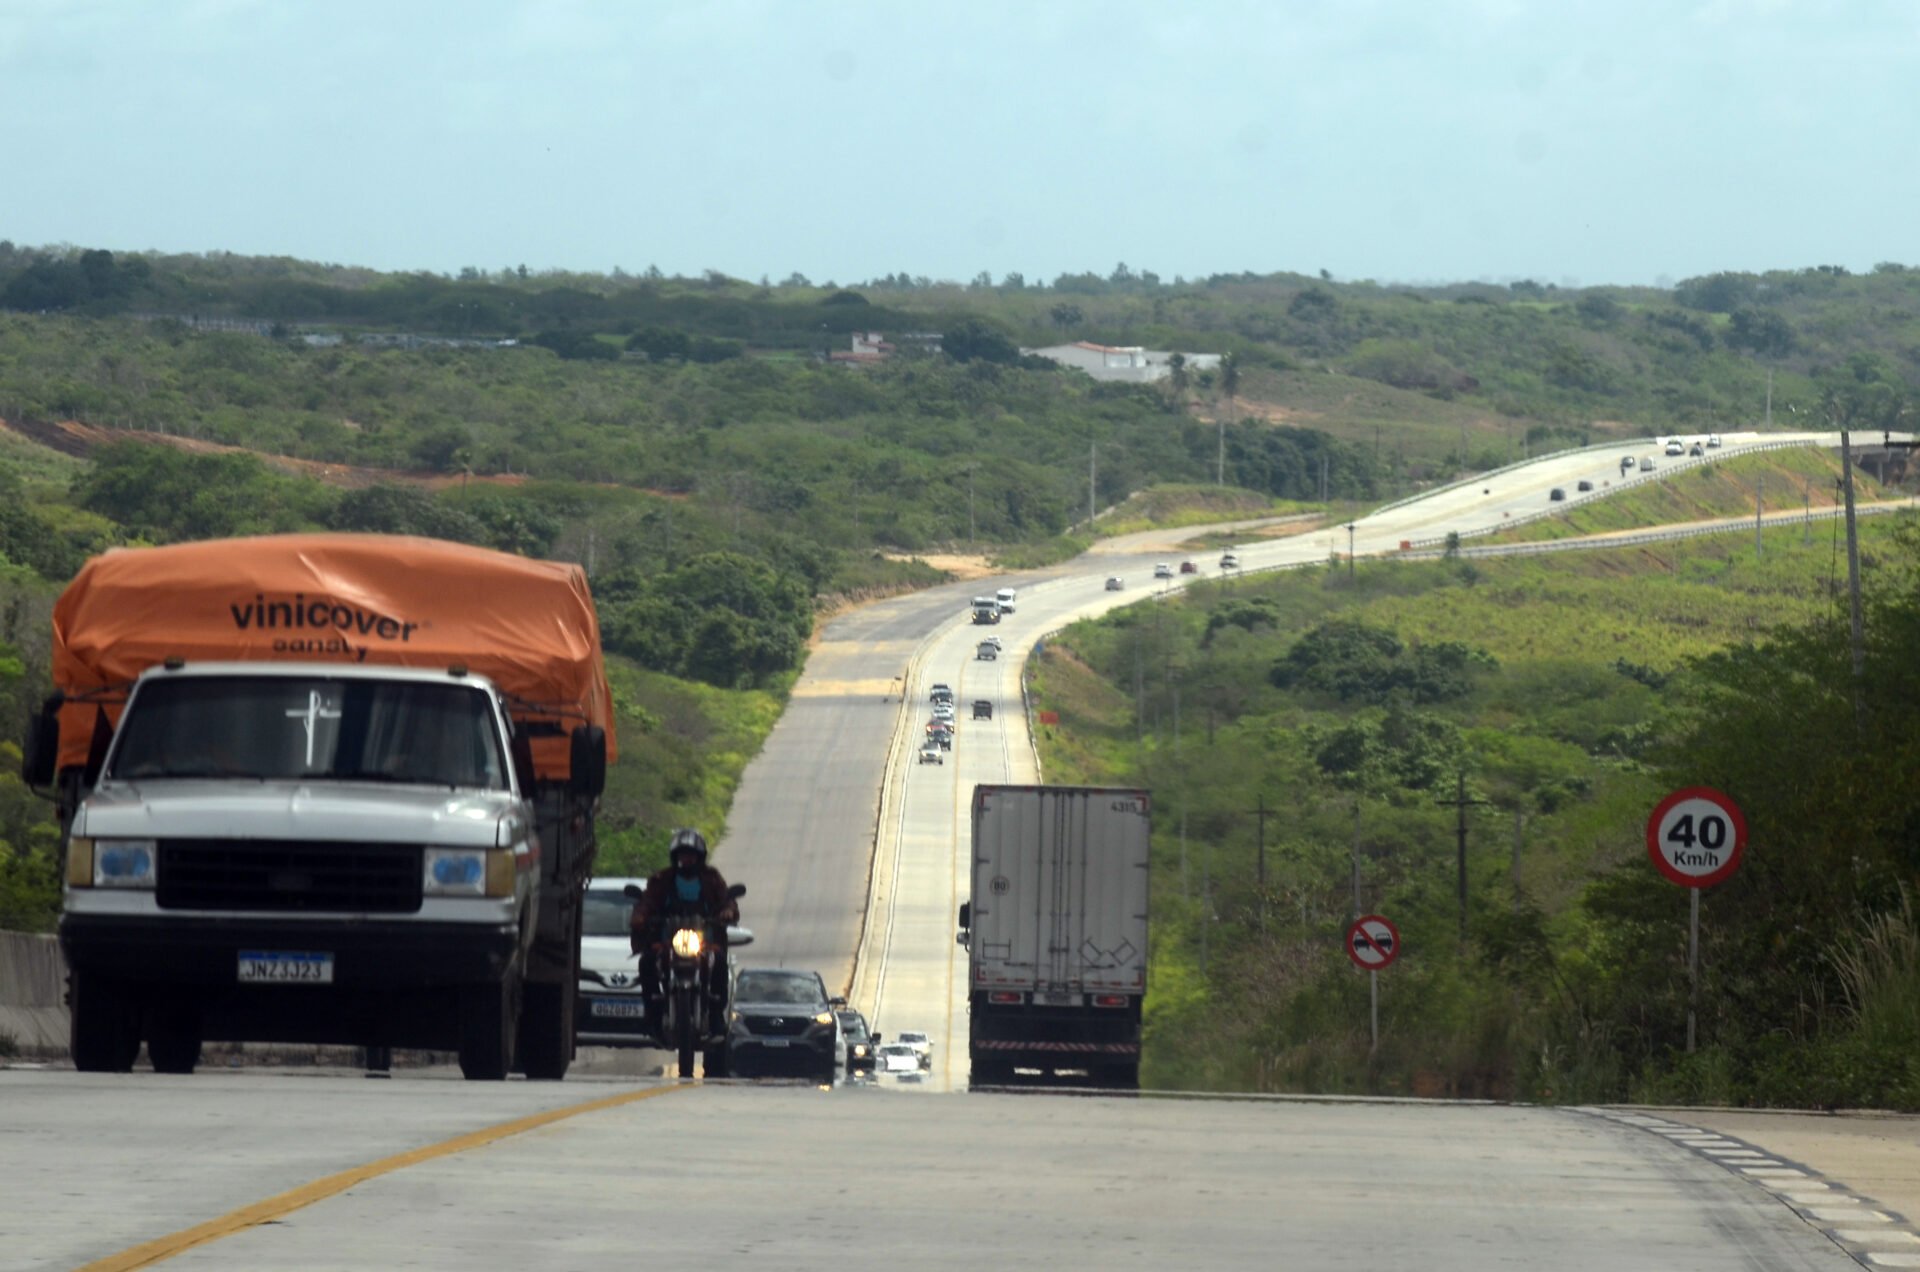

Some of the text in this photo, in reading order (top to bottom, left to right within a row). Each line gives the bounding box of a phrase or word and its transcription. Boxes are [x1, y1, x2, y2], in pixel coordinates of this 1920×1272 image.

[230, 593, 418, 642] vinicover
[1667, 814, 1726, 849] 40
[1674, 850, 1718, 866] Km/h
